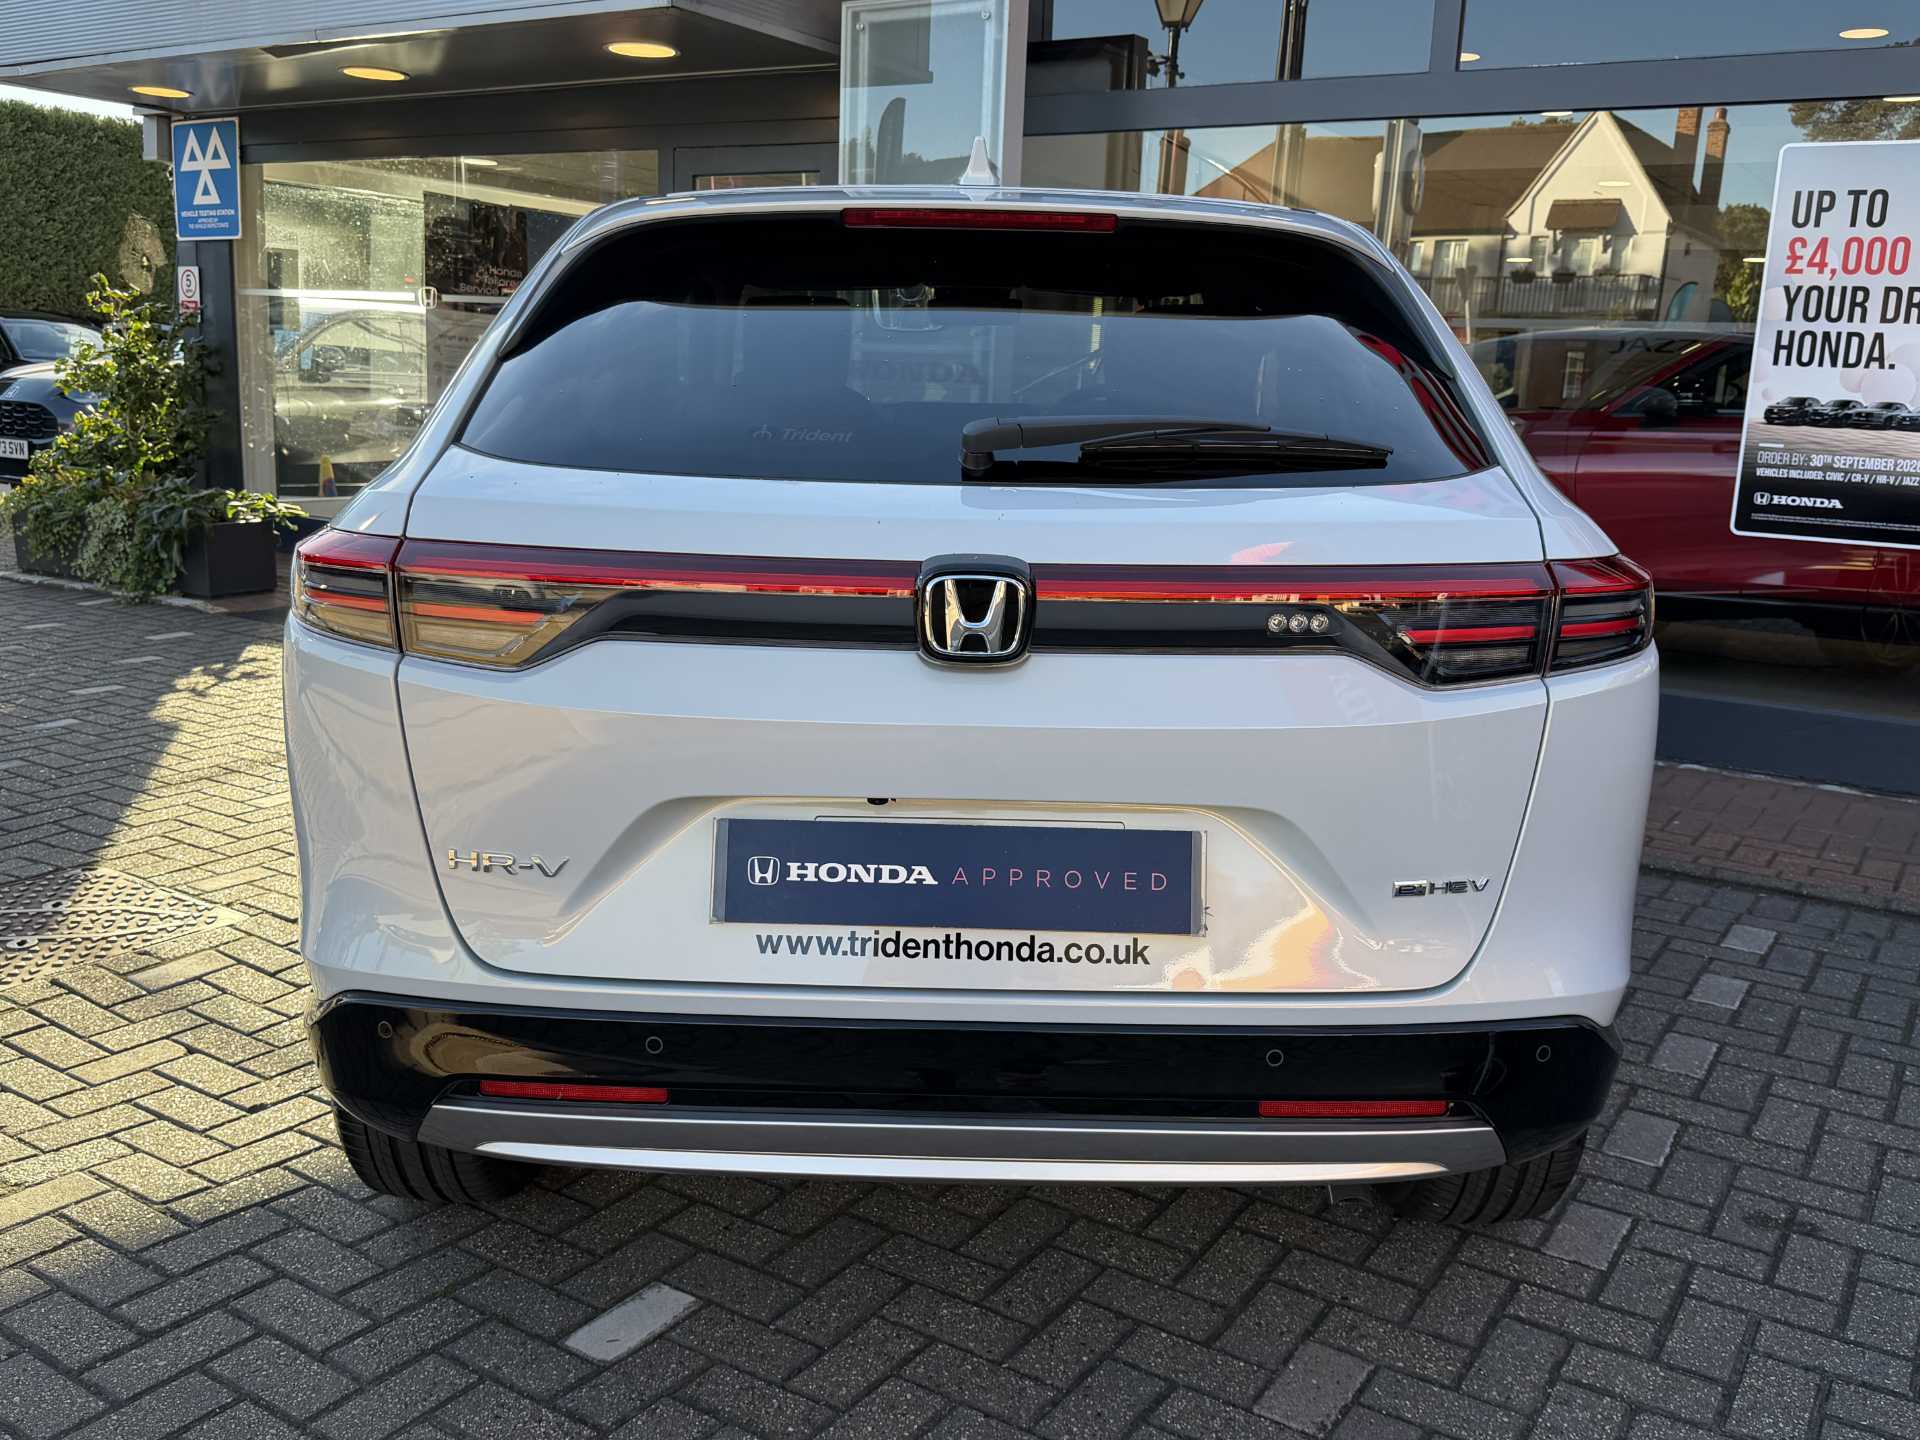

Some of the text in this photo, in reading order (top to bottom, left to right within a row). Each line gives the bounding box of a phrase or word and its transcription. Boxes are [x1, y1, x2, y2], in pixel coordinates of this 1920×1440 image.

[1792, 189, 1889, 228] UP TO
[1785, 236, 1912, 281] £4,000
[185, 274, 192, 288] 5
[1783, 285, 1920, 324] YOUR DR
[1772, 330, 1895, 370] HONDA.
[782, 427, 855, 443] Trident
[1757, 451, 1790, 465] ORDER
[1791, 453, 1808, 467] BY:
[1833, 455, 1895, 471] SEPTEMBER
[1756, 467, 1788, 478] VEHICLES
[1788, 469, 1824, 480] INCLUDED:
[1825, 471, 1844, 482] CIVIC
[1902, 476, 1920, 486] JAZZ
[1771, 494, 1843, 509] HONDA
[448, 848, 569, 877] HR-V
[786, 862, 1167, 891] HONDA APPROVED
[756, 929, 1151, 965] www.tridenthonda.co.uk
